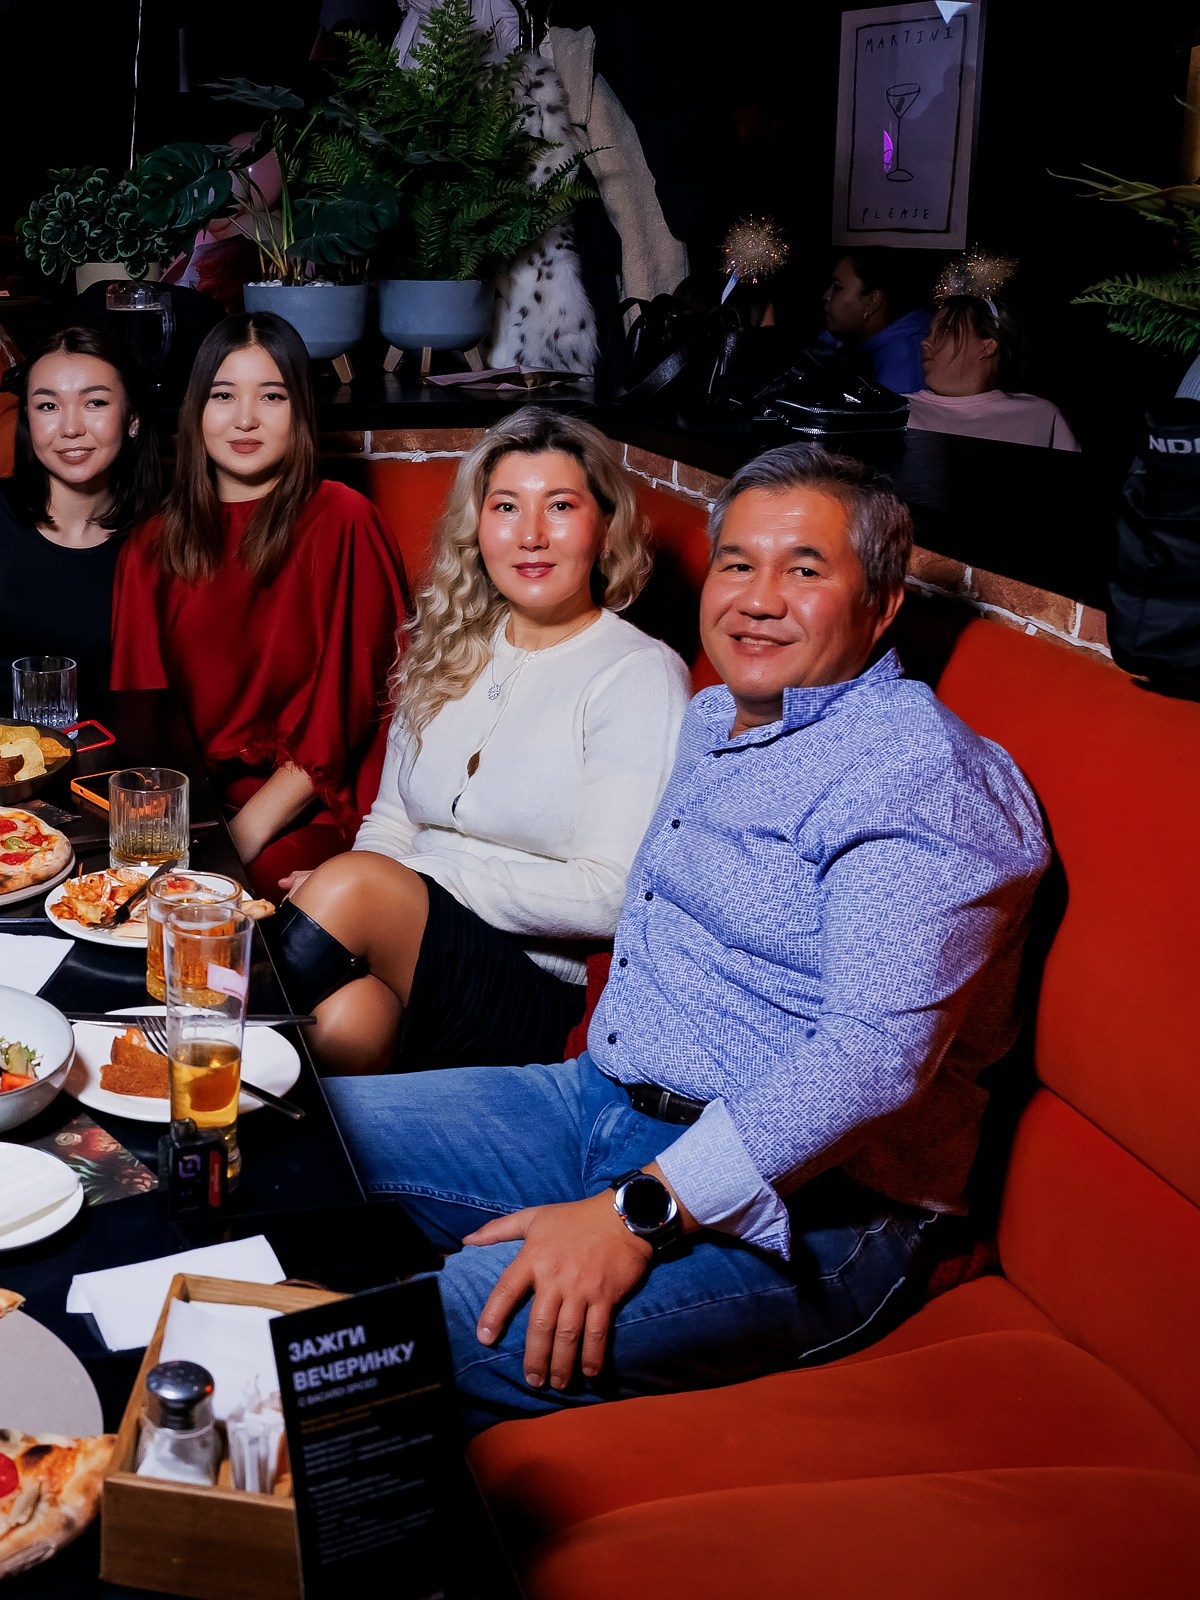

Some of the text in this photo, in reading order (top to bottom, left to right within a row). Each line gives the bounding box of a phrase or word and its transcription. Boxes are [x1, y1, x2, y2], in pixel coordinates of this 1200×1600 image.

[865, 26, 953, 53] MARTINI
[862, 208, 930, 224] PLEASE
[288, 1324, 366, 1362] ЗАЖГИ
[292, 1340, 416, 1392] ВЕЧЕРИНКУ
